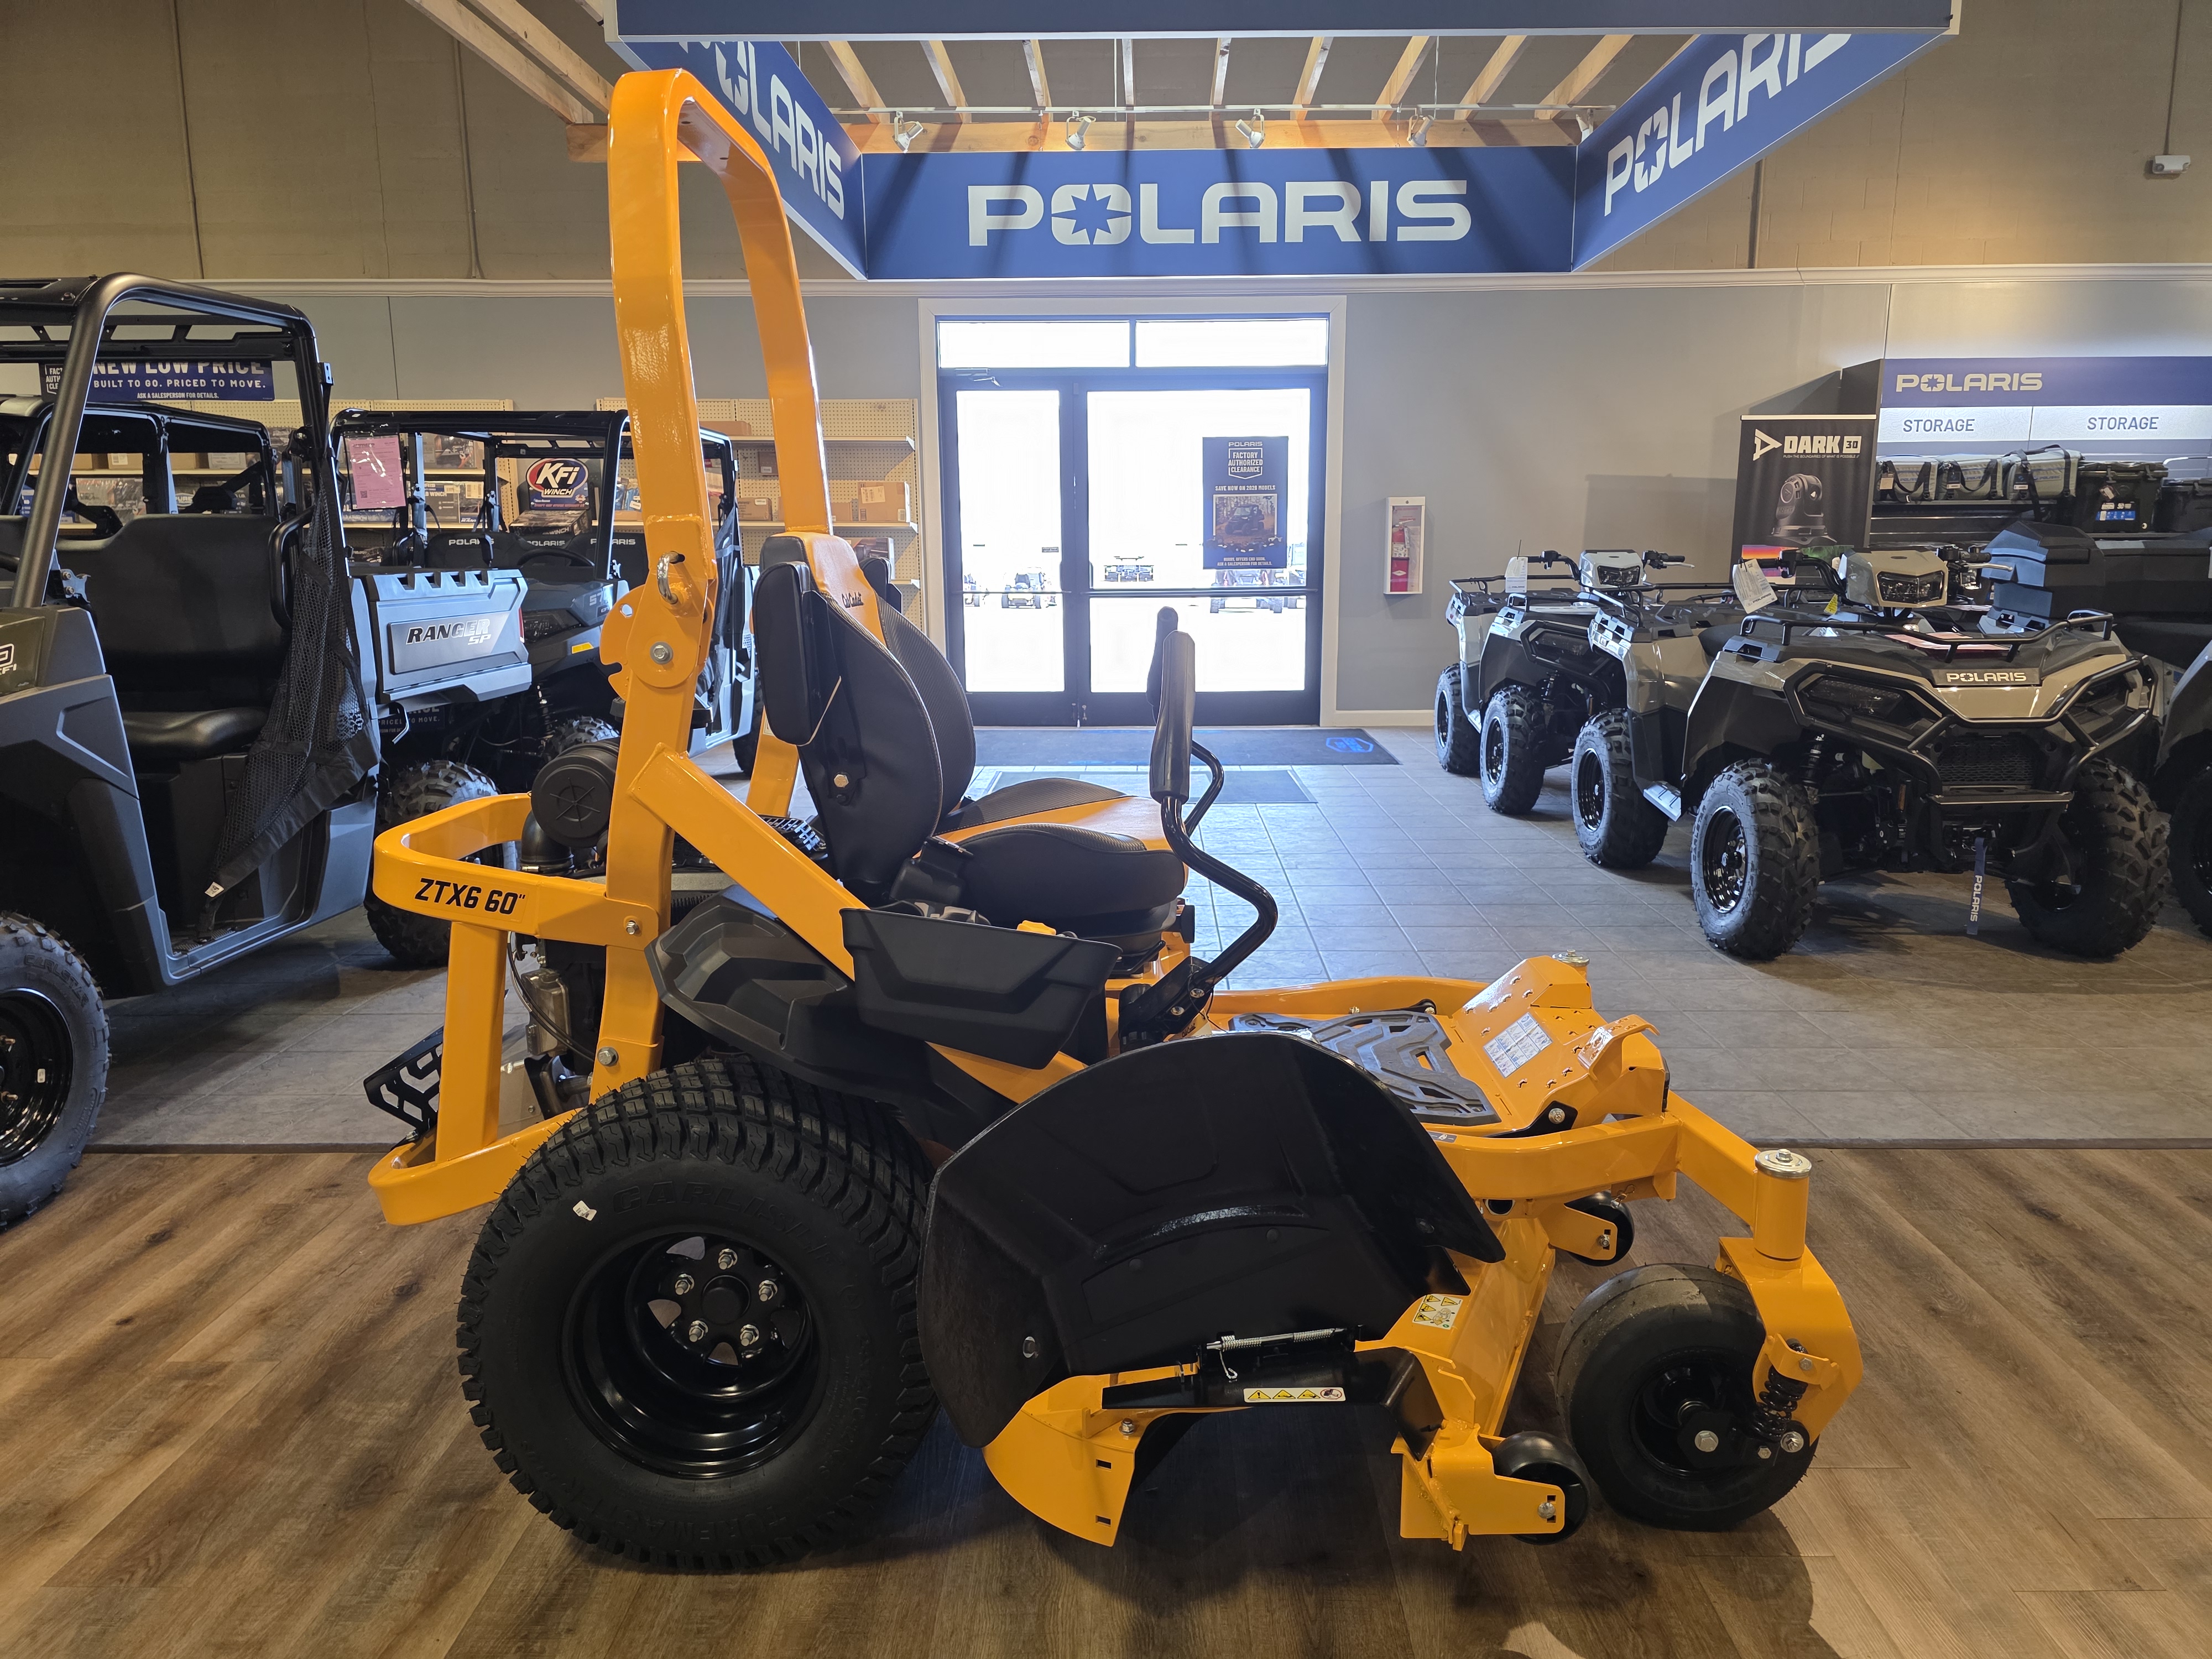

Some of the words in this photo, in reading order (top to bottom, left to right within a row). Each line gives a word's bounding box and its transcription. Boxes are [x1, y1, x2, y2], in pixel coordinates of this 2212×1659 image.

[680, 41, 844, 220] OLARIS
[968, 180, 1472, 247] POLARIS
[93, 362, 137, 374] NEW
[145, 362, 189, 374] LOW
[197, 362, 264, 374] PRICE
[93, 380, 123, 388] BUILT
[128, 379, 140, 388] TO
[145, 379, 163, 388] GO.
[230, 379, 266, 388] MOVE.
[1895, 373, 2043, 392] POLARIS
[1903, 419, 1975, 432] STORAGE
[2087, 416, 2159, 430] STORAGE
[1783, 436, 1840, 453] DARK
[536, 463, 580, 488] KFi
[549, 526, 570, 535] WINCH
[406, 619, 491, 645] RANGER
[468, 634, 492, 645] SP
[1947, 672, 2027, 682] POLARIS
[414, 878, 482, 909] ZTX6
[484, 889, 526, 915] 60"
[1970, 875, 1983, 922] POLARIS
